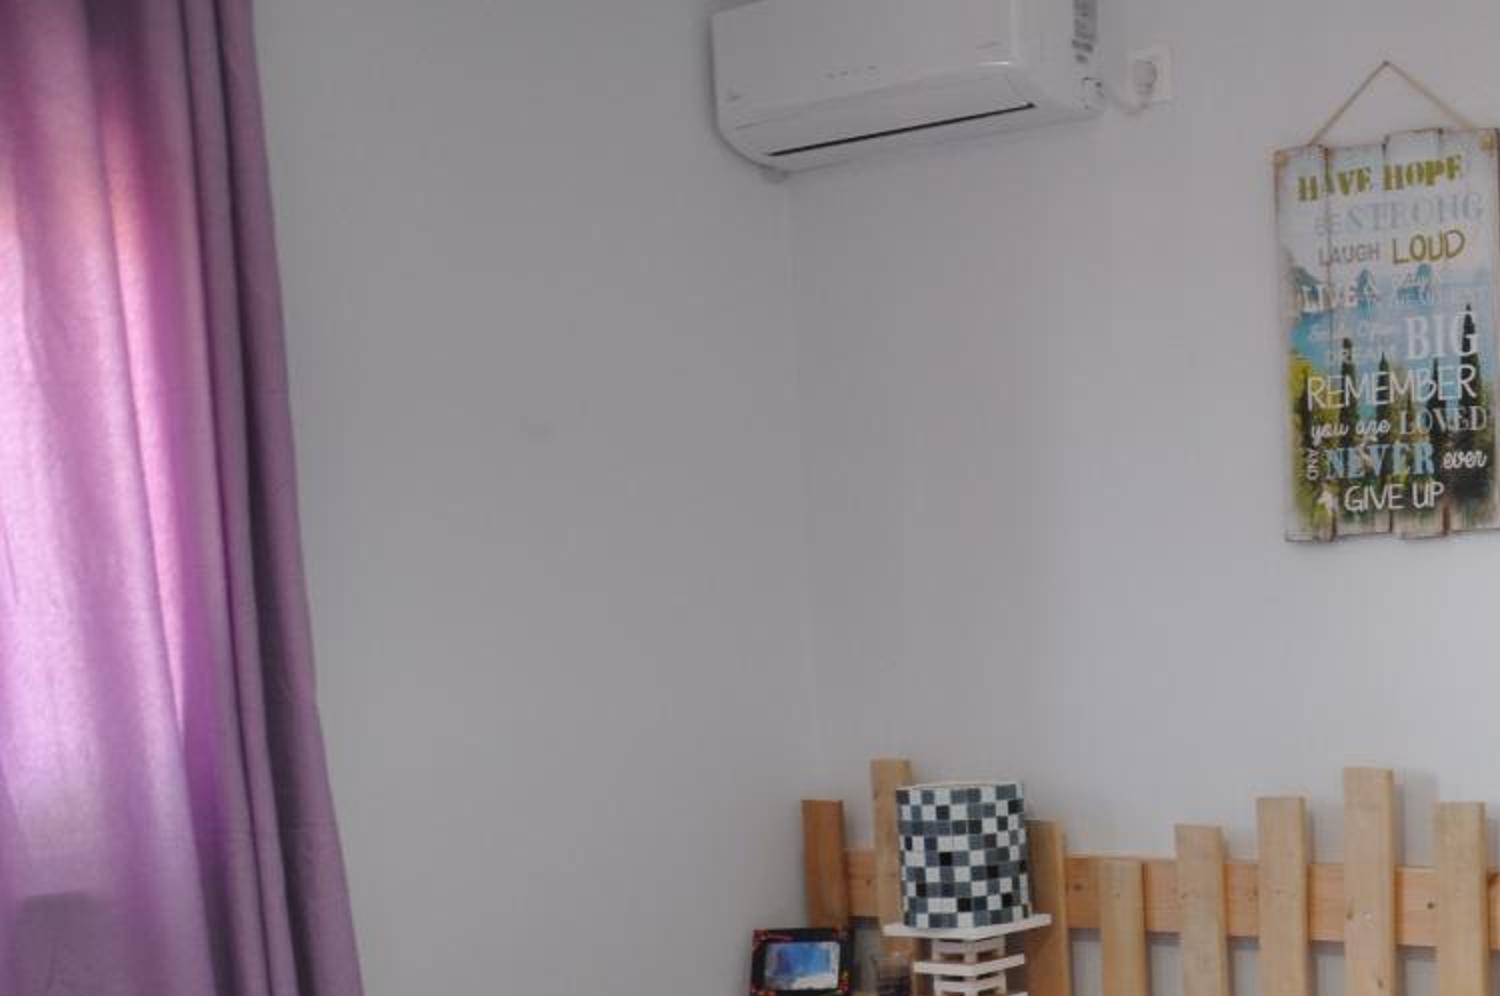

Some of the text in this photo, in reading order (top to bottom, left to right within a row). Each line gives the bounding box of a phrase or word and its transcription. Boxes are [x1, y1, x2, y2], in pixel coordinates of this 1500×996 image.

[1298, 154, 1462, 201] HAVE HOPE
[1318, 229, 1466, 267] LAUGH LOUD
[1407, 311, 1480, 360] BIG
[1307, 363, 1477, 411] REMEMBER
[1401, 406, 1487, 435] LOVED
[1325, 441, 1435, 479] NEVER
[1344, 481, 1446, 511] GIVE UP
